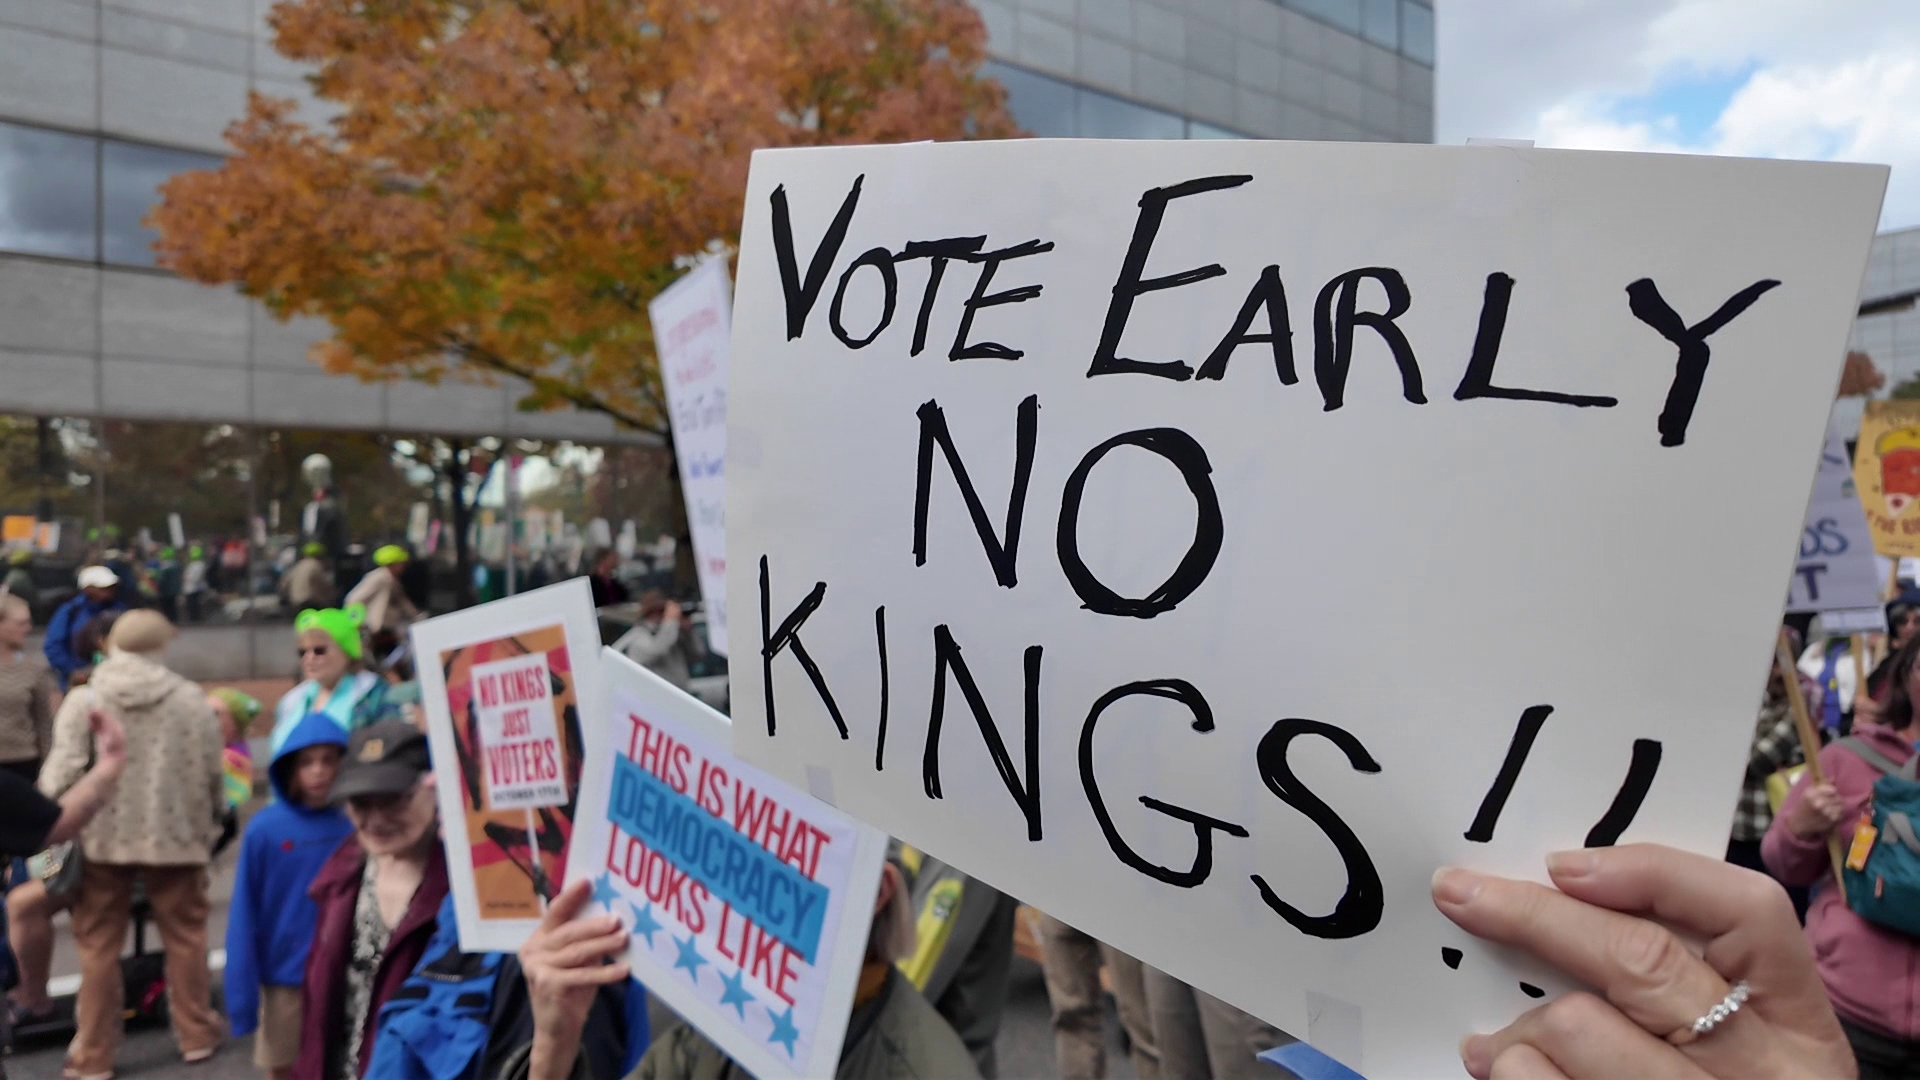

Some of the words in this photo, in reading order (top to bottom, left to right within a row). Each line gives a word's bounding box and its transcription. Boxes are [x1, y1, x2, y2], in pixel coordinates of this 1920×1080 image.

[769, 173, 1055, 362] VOTE
[1086, 174, 1782, 448] EARLY
[911, 393, 1224, 620] NO
[478, 674, 498, 708] NO
[500, 664, 547, 704] KINGS
[487, 739, 558, 786] VOTERS
[502, 707, 531, 738] JUST
[617, 766, 817, 938] DEMOCRACY
[626, 713, 692, 795] THIS
[695, 758, 728, 819] IS
[733, 778, 831, 881] WHAT
[606, 822, 709, 934] LOOKS
[716, 900, 804, 1007] LIKE
